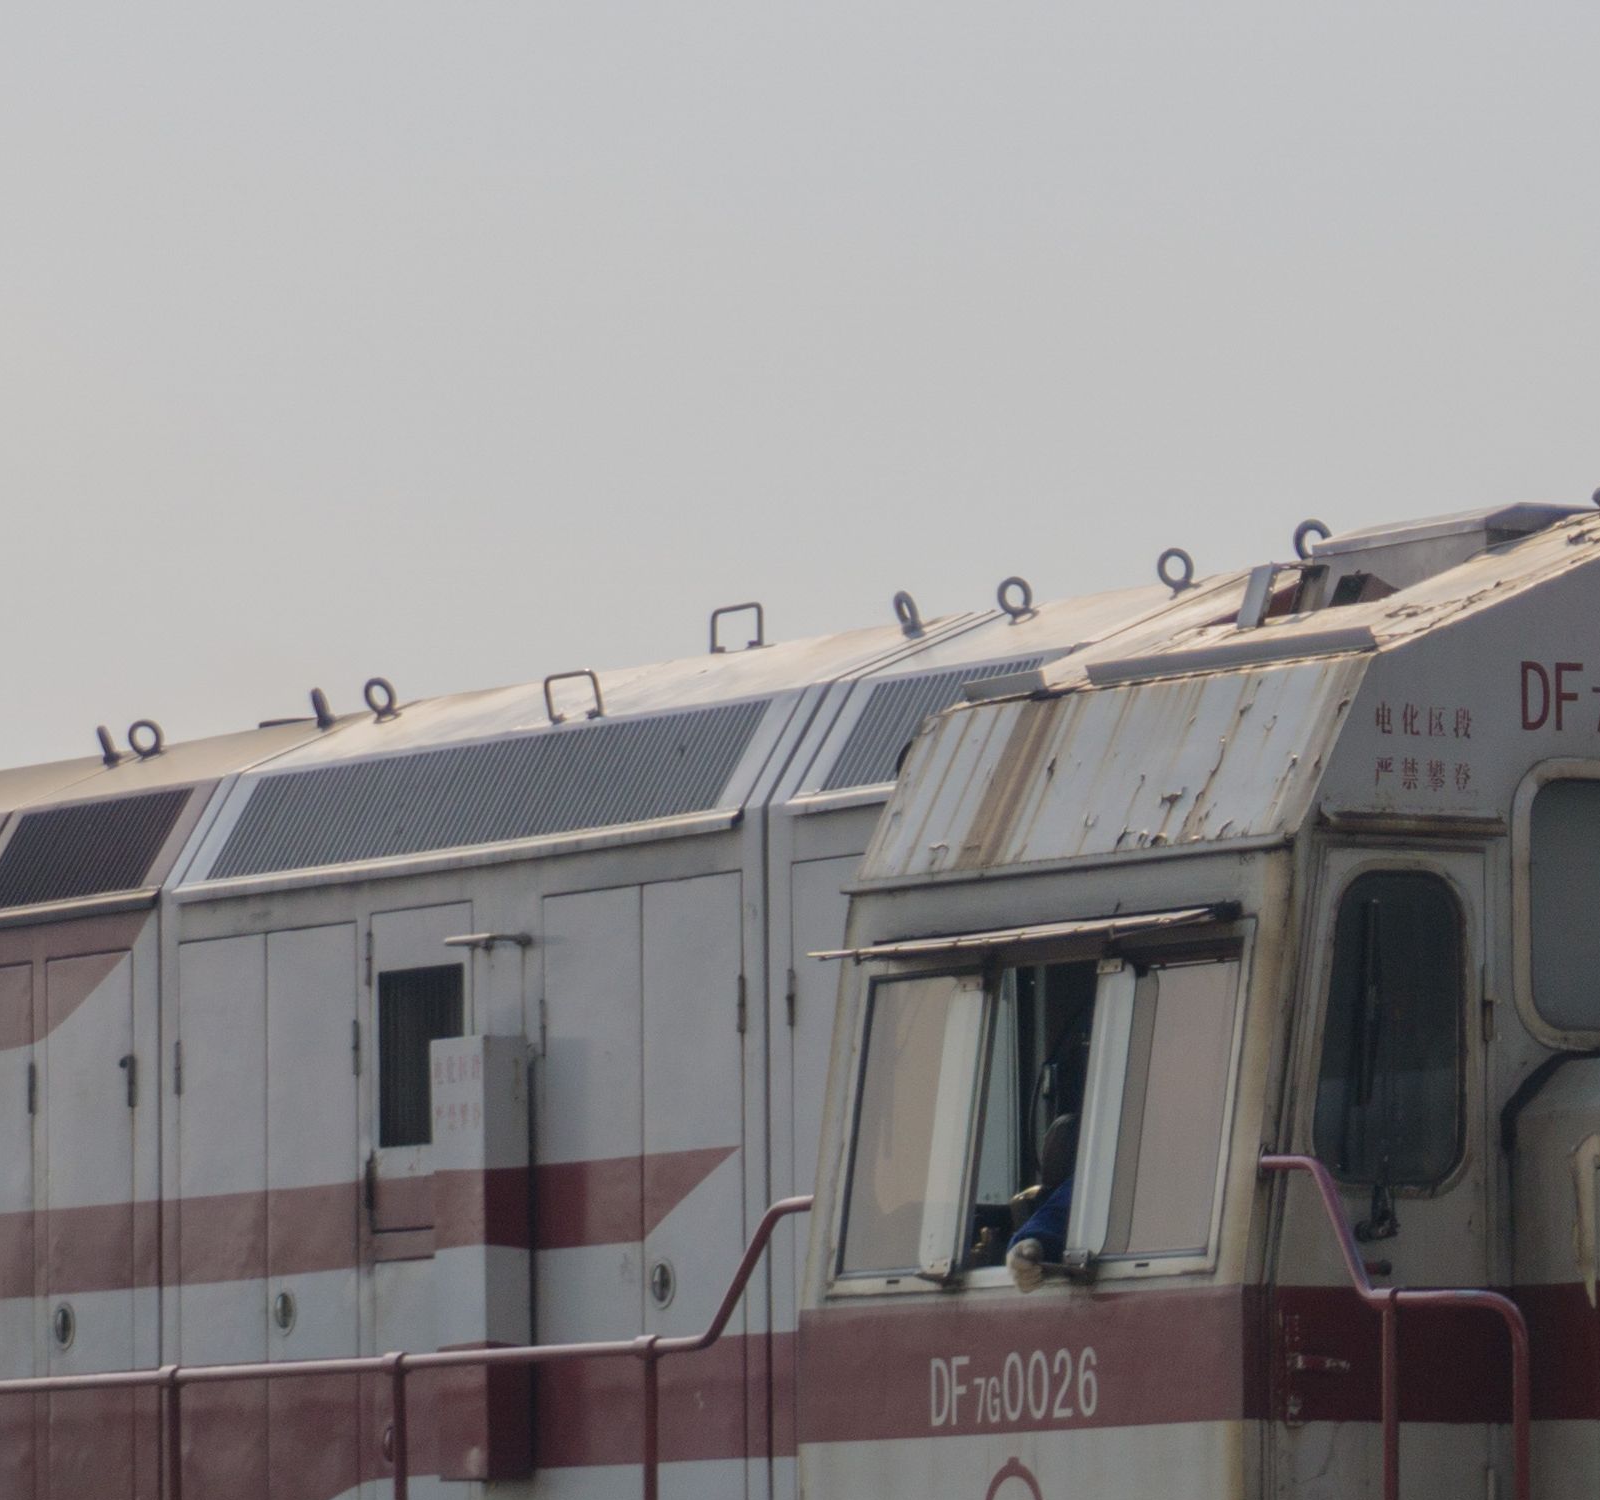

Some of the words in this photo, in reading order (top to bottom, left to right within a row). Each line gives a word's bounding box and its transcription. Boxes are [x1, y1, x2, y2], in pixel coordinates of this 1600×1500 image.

[1374, 700, 1473, 739] 电化区段
[1374, 756, 1475, 793] 严禁攀登
